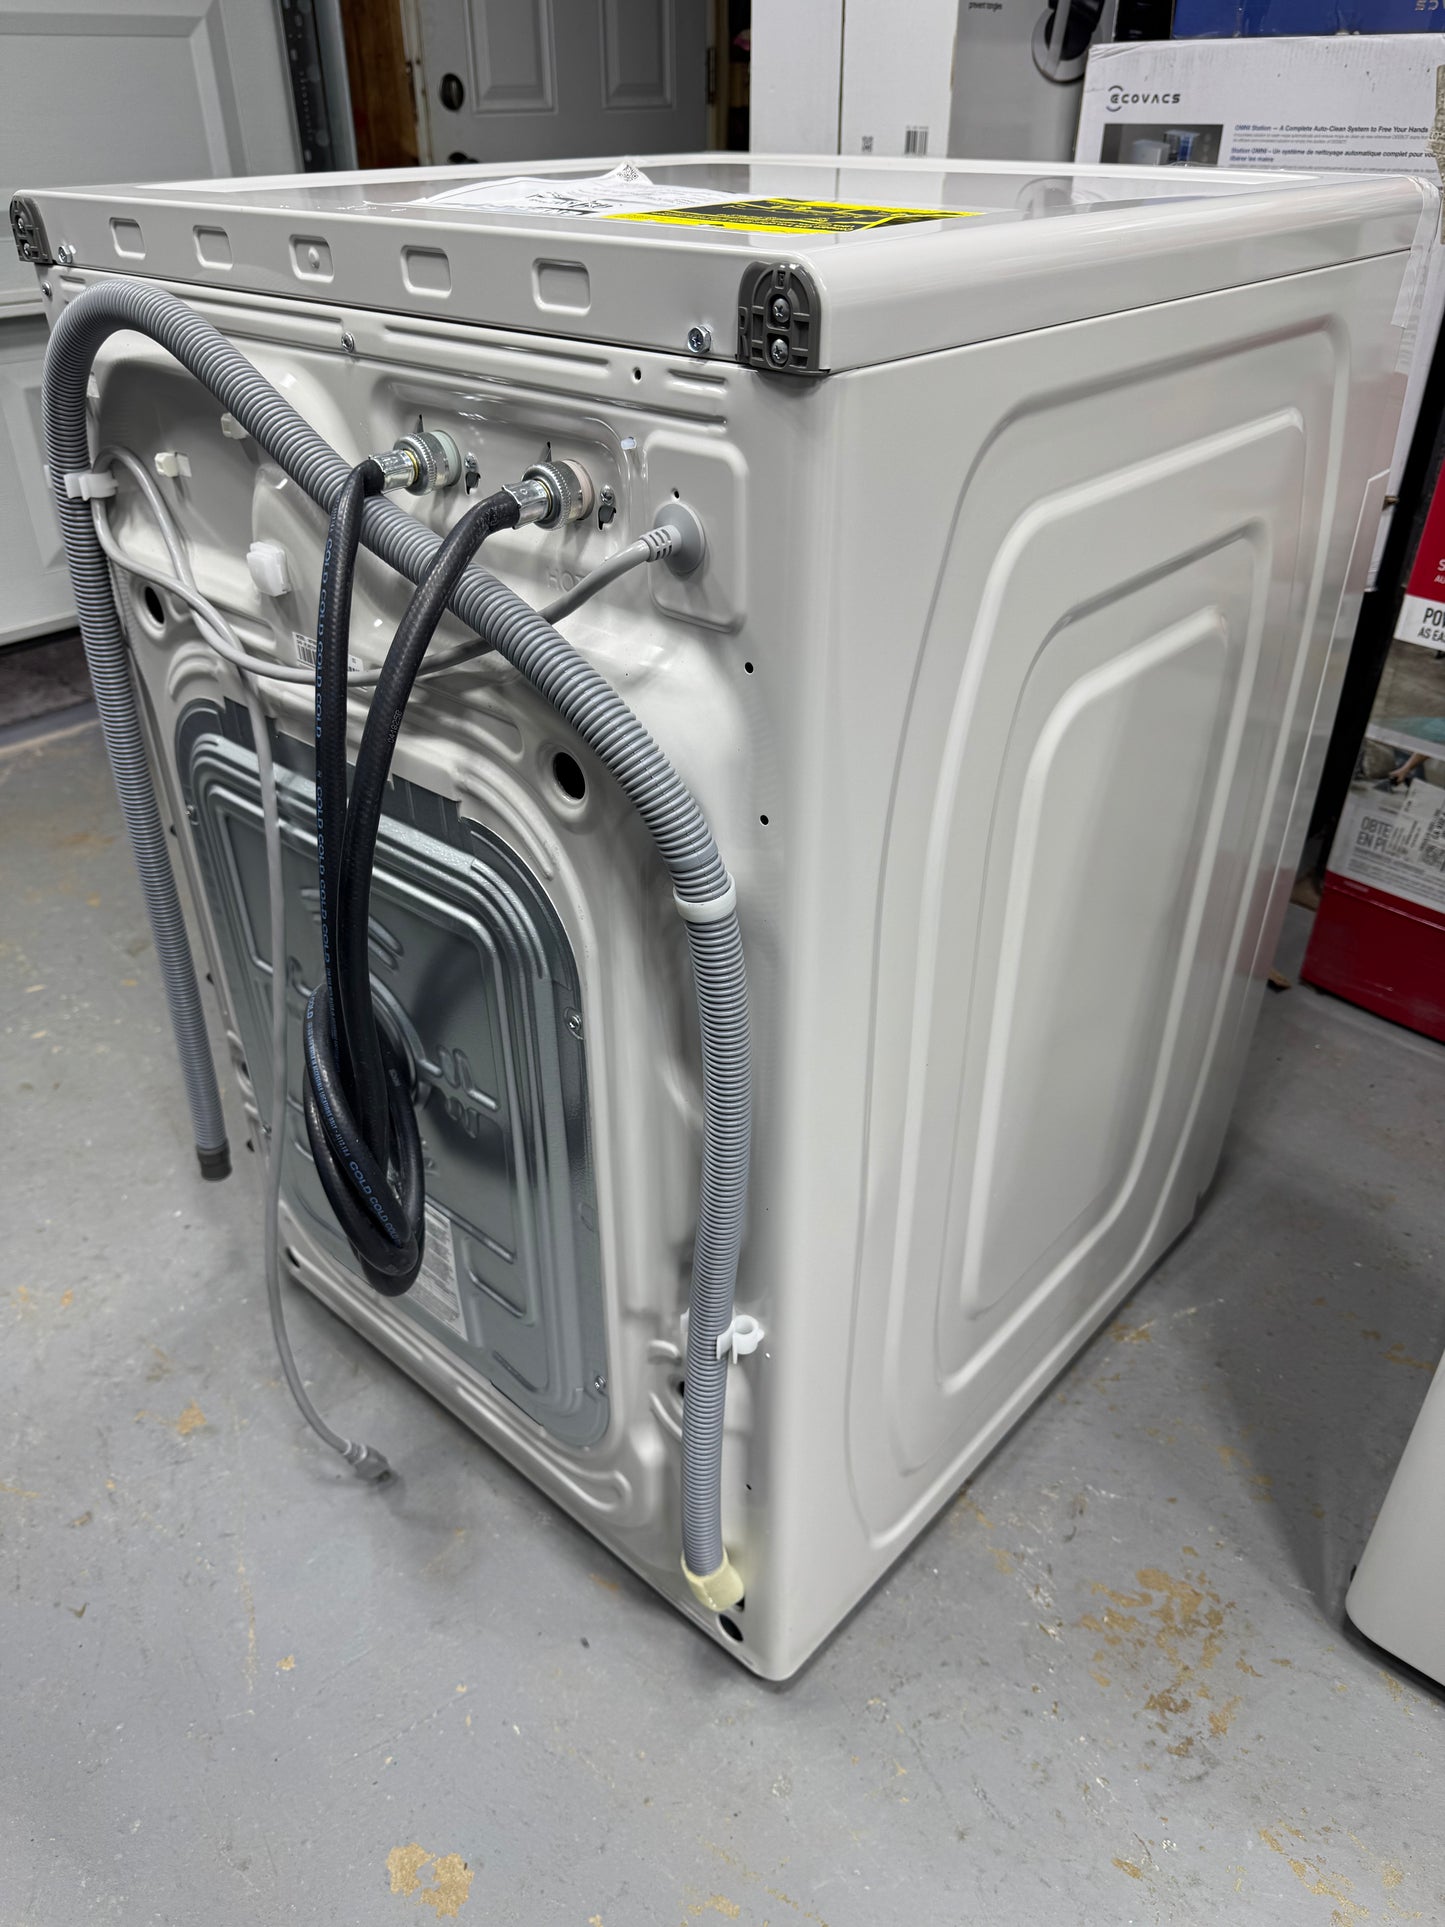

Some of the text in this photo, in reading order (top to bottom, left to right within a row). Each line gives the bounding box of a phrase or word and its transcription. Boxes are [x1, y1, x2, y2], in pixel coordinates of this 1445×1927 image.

[1109, 92, 1182, 105] ECOVACS
[1285, 125, 1313, 133] Complete
[1314, 149, 1343, 157] nettoyage
[322, 538, 333, 584] COLD
[318, 588, 327, 635] COLD
[1422, 607, 1445, 628] PO
[1417, 627, 1430, 639] AS
[1361, 816, 1393, 836] OBTE
[318, 833, 326, 875] COLD
[320, 879, 328, 920] COLD
[322, 923, 331, 963] COLD
[349, 1160, 373, 1195] COLD
[369, 1196, 389, 1222] COLD
